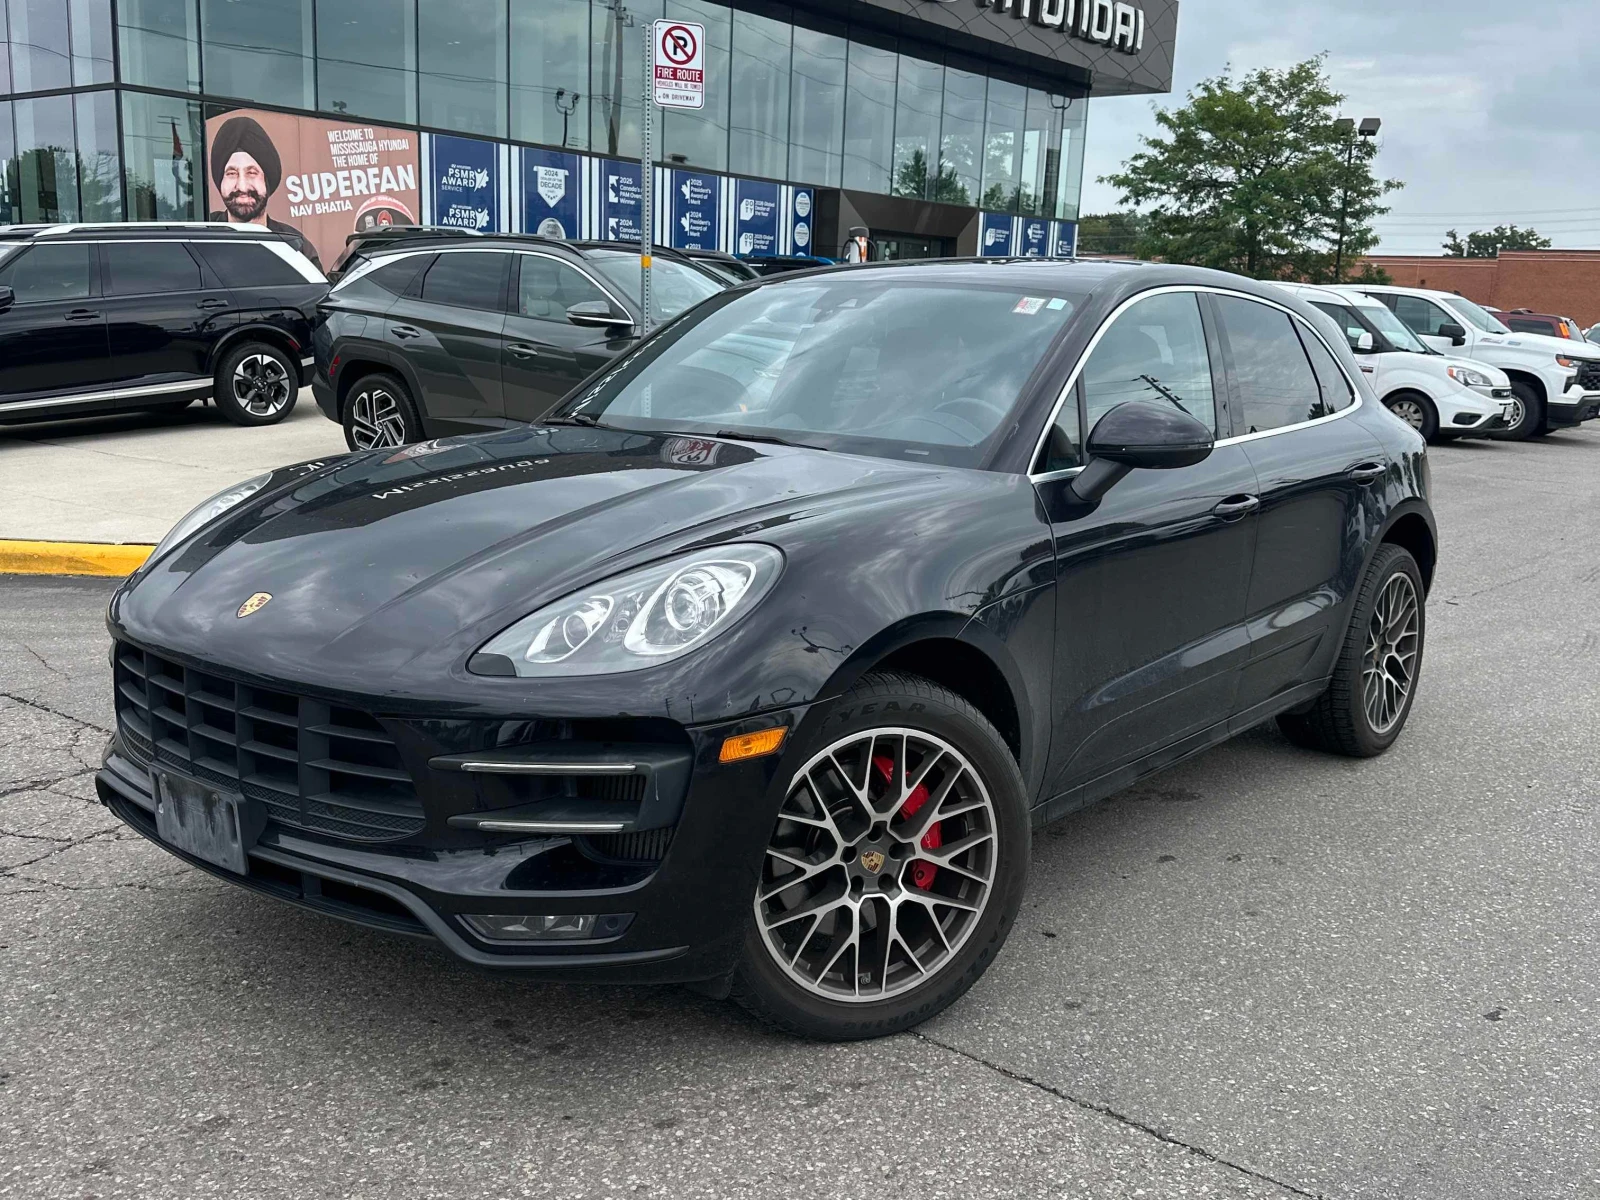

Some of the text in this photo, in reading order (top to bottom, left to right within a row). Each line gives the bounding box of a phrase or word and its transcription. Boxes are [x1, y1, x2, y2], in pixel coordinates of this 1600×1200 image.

[657, 67, 701, 82] FIRE ROUTE
[672, 94, 696, 102] DRIVEWAY
[327, 128, 374, 142] WELCOME TO
[330, 139, 409, 155] MISSISSAUGA HYUNDAI
[332, 153, 378, 168] THE HOME OF
[448, 168, 475, 179] PSMR
[286, 164, 416, 203] SUPERFAN
[442, 176, 475, 187] AWARD
[540, 181, 562, 189] DECADE
[620, 177, 633, 185] 2025
[290, 204, 312, 218] NAV
[315, 200, 353, 214] BHATIA
[449, 208, 476, 219] PSMR
[442, 216, 476, 227] AWARD
